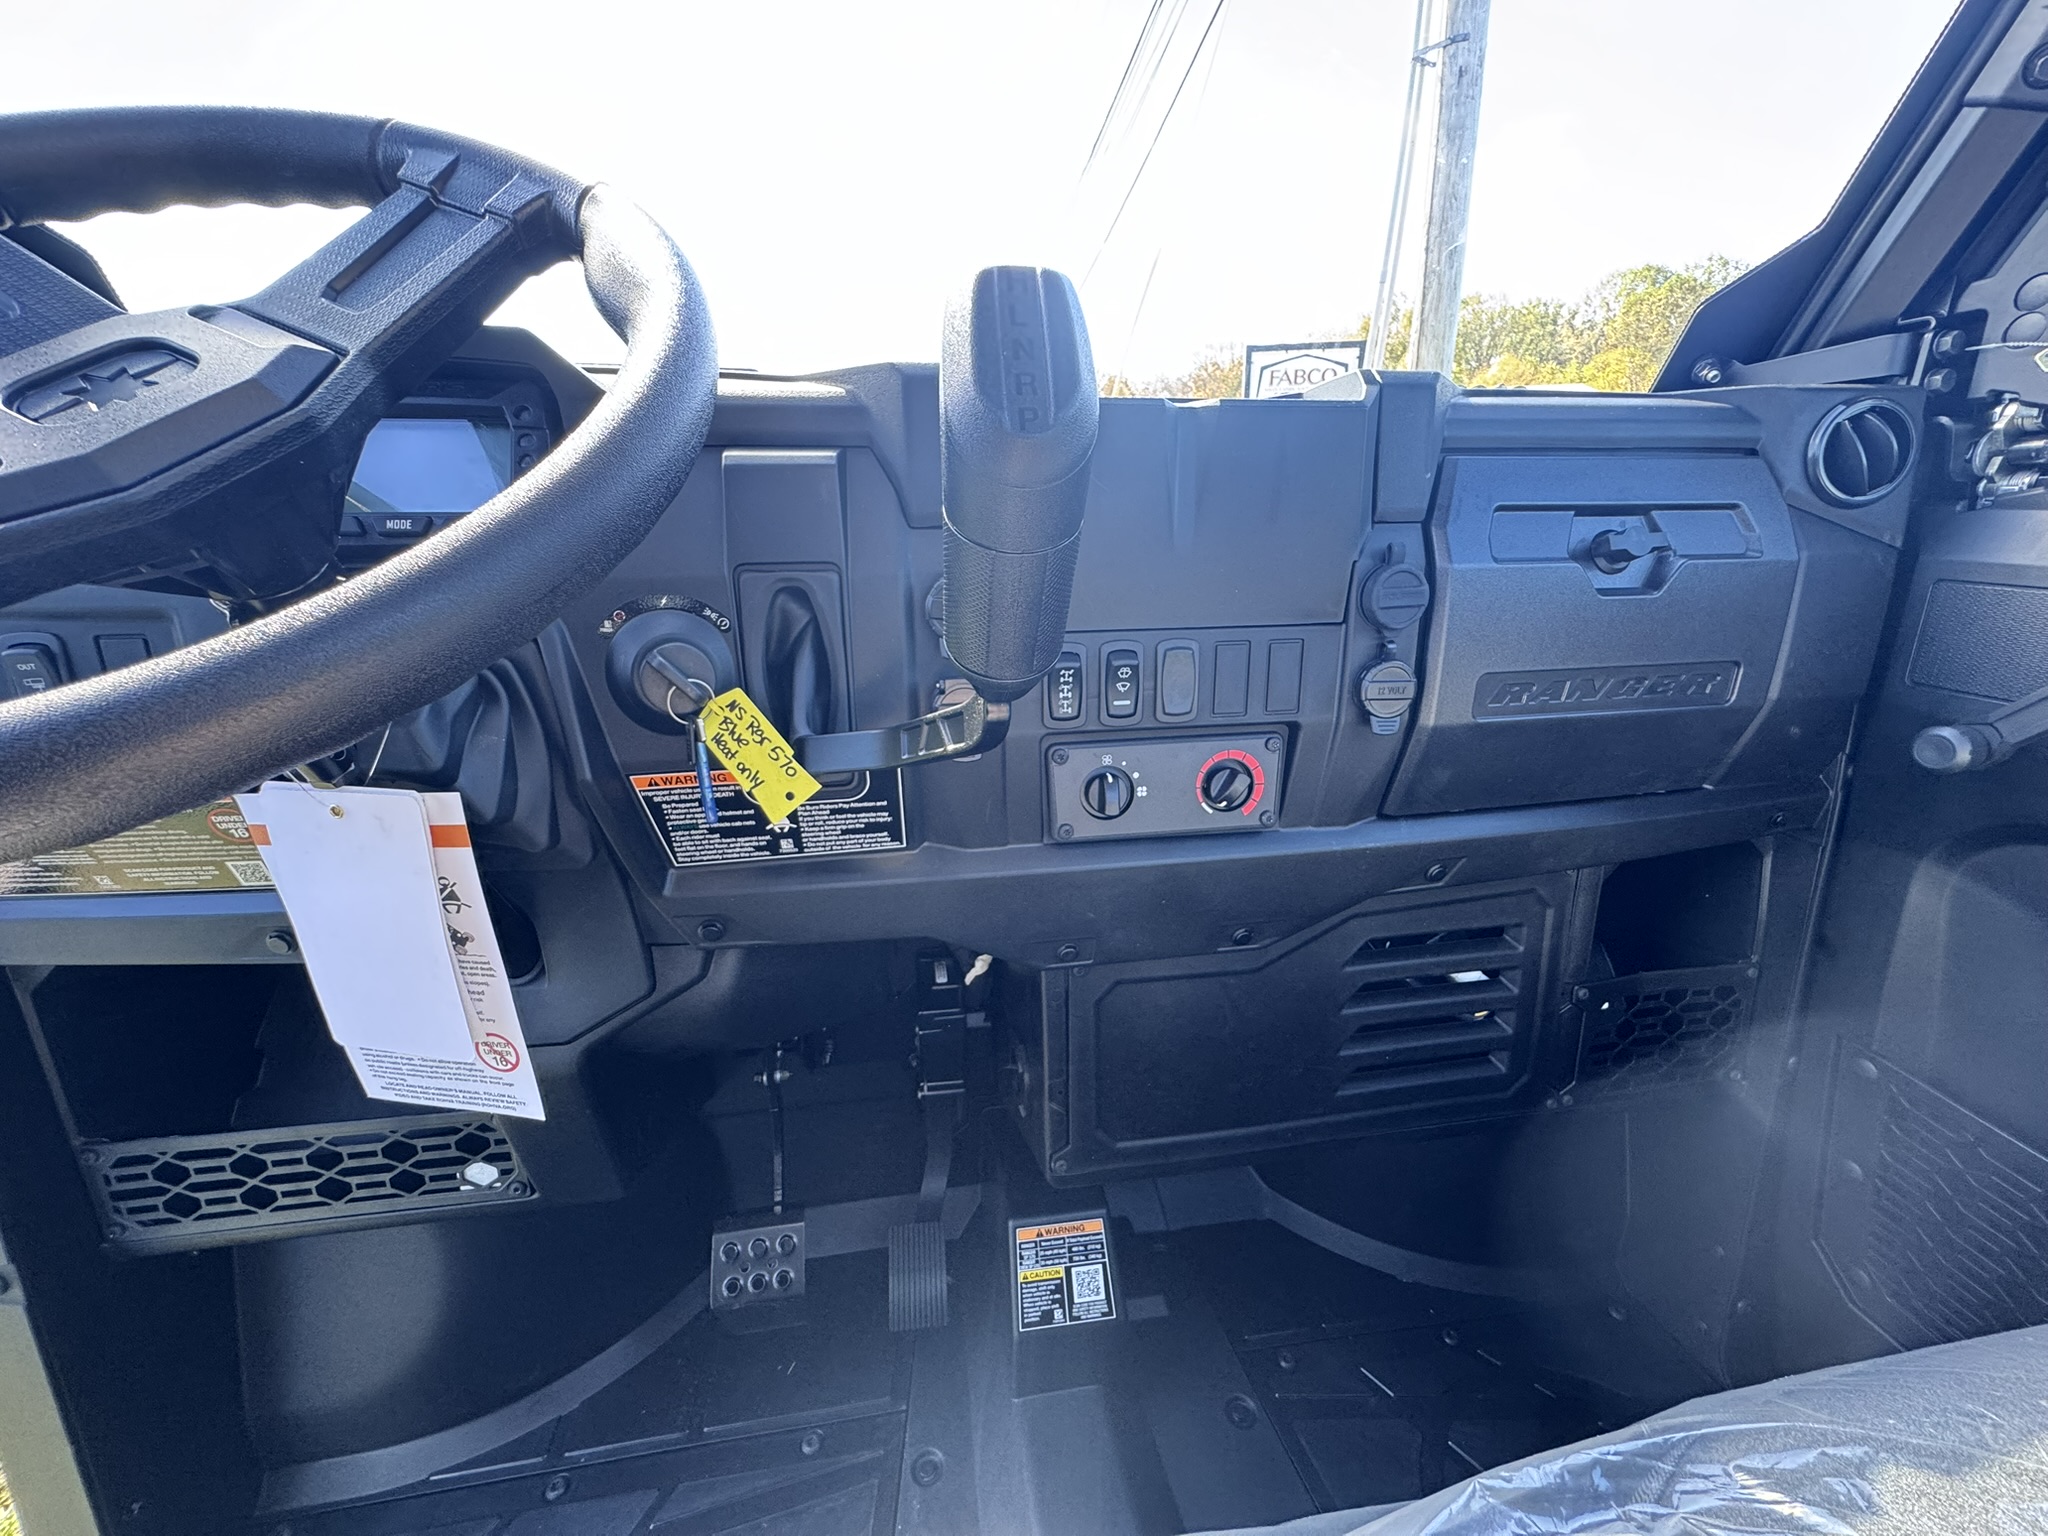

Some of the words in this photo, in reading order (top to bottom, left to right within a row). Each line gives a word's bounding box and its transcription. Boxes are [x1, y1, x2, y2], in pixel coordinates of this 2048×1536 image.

[1008, 304, 1027, 327] L
[1011, 336, 1034, 361] N
[1015, 372, 1038, 396] R
[1018, 406, 1039, 431] P
[386, 519, 412, 530] MODE
[1377, 687, 1386, 695] 12
[1387, 686, 1407, 695] VOLT
[1487, 671, 1721, 707] RANGER
[718, 715, 750, 748] Blue
[725, 699, 747, 721] NS
[767, 746, 797, 777] 570
[711, 732, 739, 760] Heat
[736, 762, 765, 790] only
[641, 789, 670, 797] Improper
[229, 829, 249, 838] 16
[481, 1041, 510, 1049] DRIVER
[483, 1049, 512, 1057] UNDER
[492, 1056, 508, 1067] 16
[1044, 1224, 1085, 1236] WARNING
[1030, 1269, 1061, 1279] CAUTION
